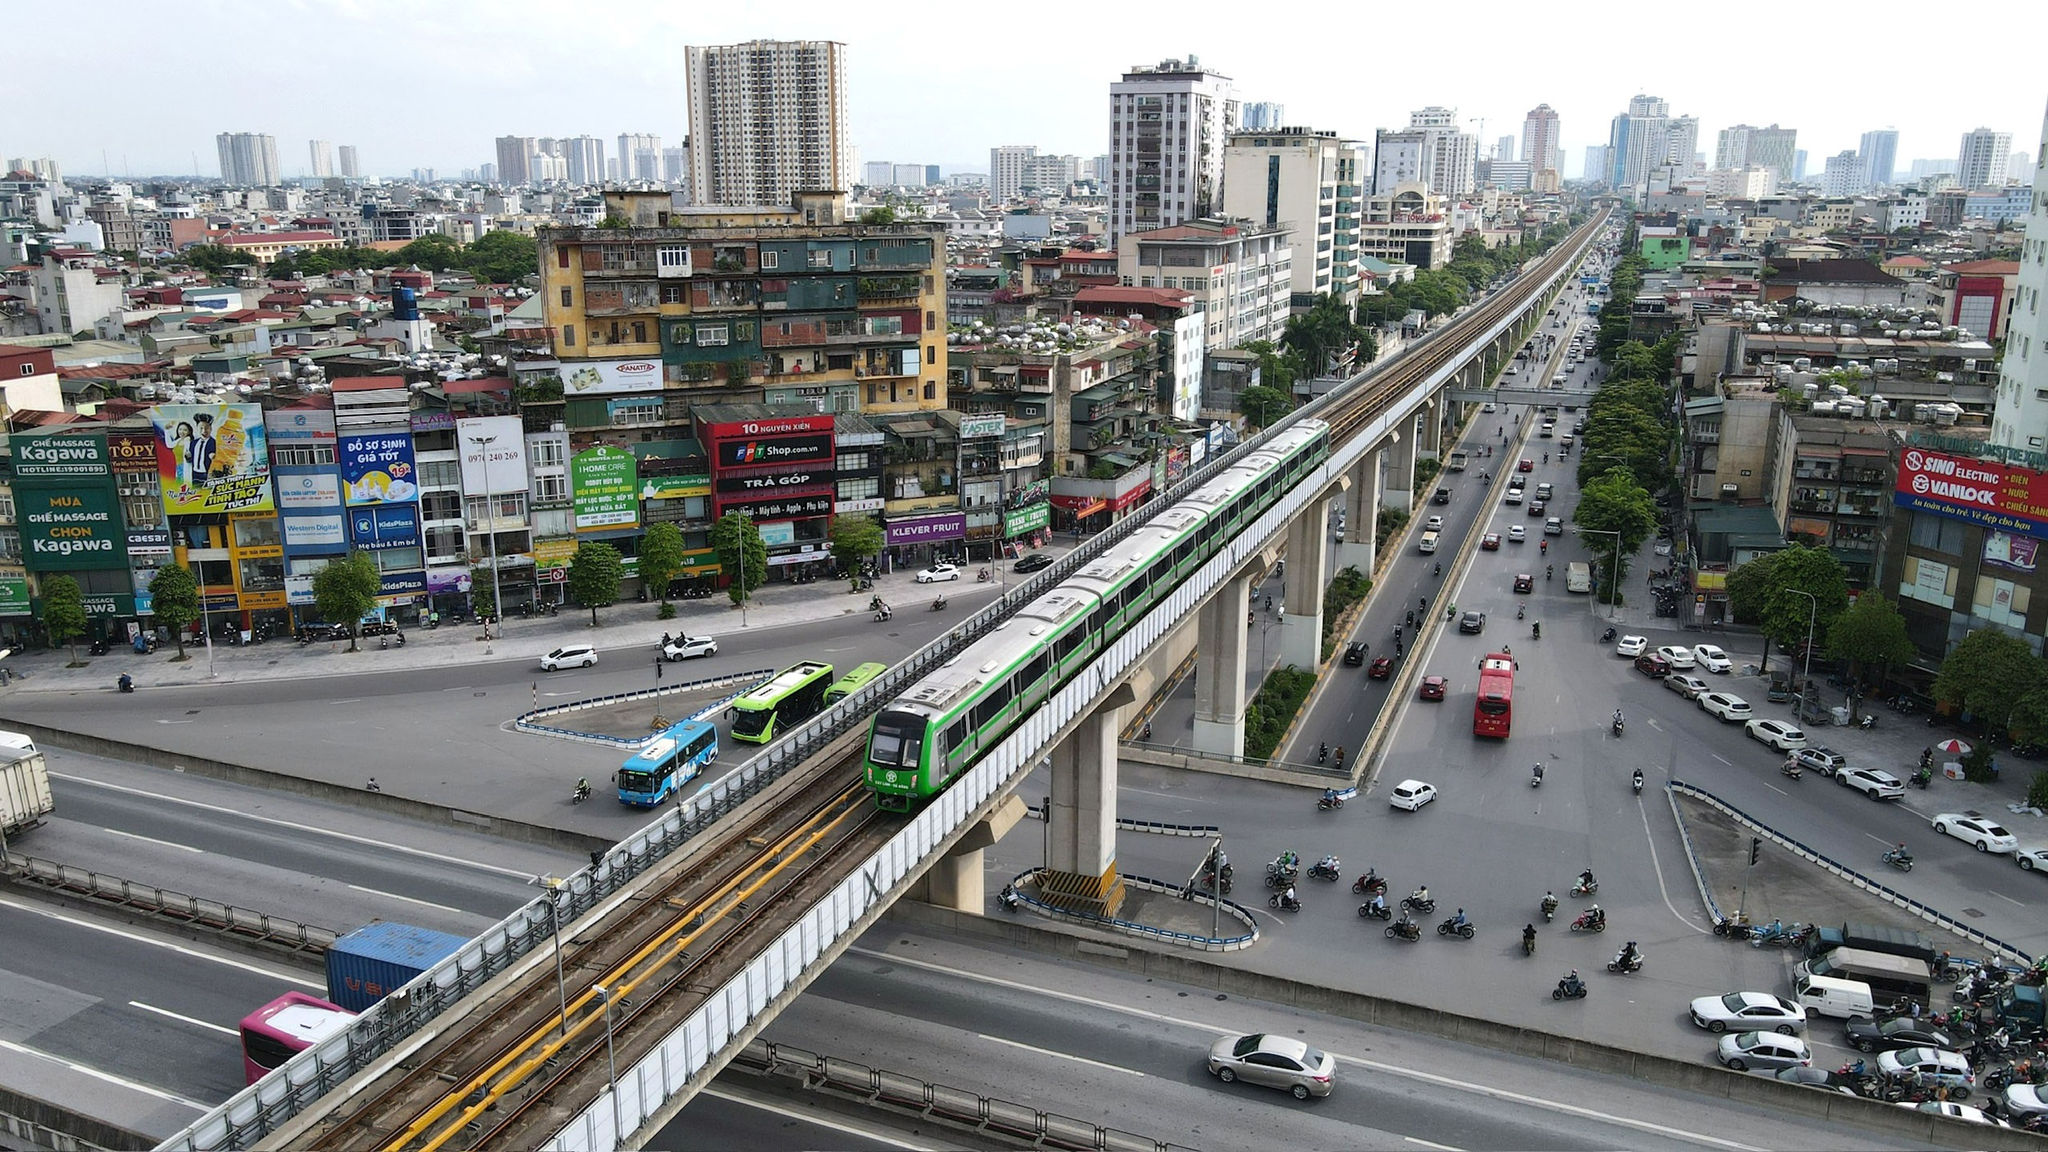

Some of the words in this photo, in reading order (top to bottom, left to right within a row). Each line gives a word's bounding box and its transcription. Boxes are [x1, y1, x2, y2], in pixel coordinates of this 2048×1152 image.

[742, 423, 759, 434] 10
[760, 422, 791, 433] NGUYỄN
[963, 421, 1002, 434] FASTER
[108, 444, 154, 458] TOPY
[347, 438, 363, 452] ĐỒ
[365, 441, 379, 450] SƠ
[381, 439, 406, 449] SINH
[767, 445, 818, 456] Shop.com.vn
[20, 446, 98, 463] Kagawa
[378, 448, 399, 461] TỐT
[489, 452, 503, 461] 240
[505, 451, 518, 460] 269
[583, 464, 607, 473] HOME
[608, 463, 627, 471] CARE
[1923, 457, 1956, 476] SINO
[1956, 467, 2000, 485] ELECTRIC
[236, 476, 266, 489] MẠNH
[744, 475, 775, 488] TRẢ
[779, 473, 809, 485] GÓP
[1930, 479, 1996, 506] VANLOCK
[49, 497, 82, 507] MUA
[759, 506, 770, 516] Máy
[786, 503, 802, 514] Apple
[1923, 501, 1941, 511] toàn
[1941, 504, 1956, 514] cho
[1982, 512, 1998, 525] đẹp
[1998, 516, 2013, 527] cho
[2014, 519, 2031, 531] bạn
[28, 511, 53, 522] GHẾ
[53, 512, 109, 522] MASSAGE
[287, 524, 315, 532] Western
[316, 523, 339, 532] Digital
[379, 520, 414, 528] KidsPlaza
[892, 523, 930, 537] KLEVER
[932, 522, 961, 533] FRUIT
[50, 527, 92, 539] CHỌN
[128, 534, 168, 543] caesar
[33, 539, 112, 555] Kagawa
[381, 581, 422, 591] KidsPlaza
